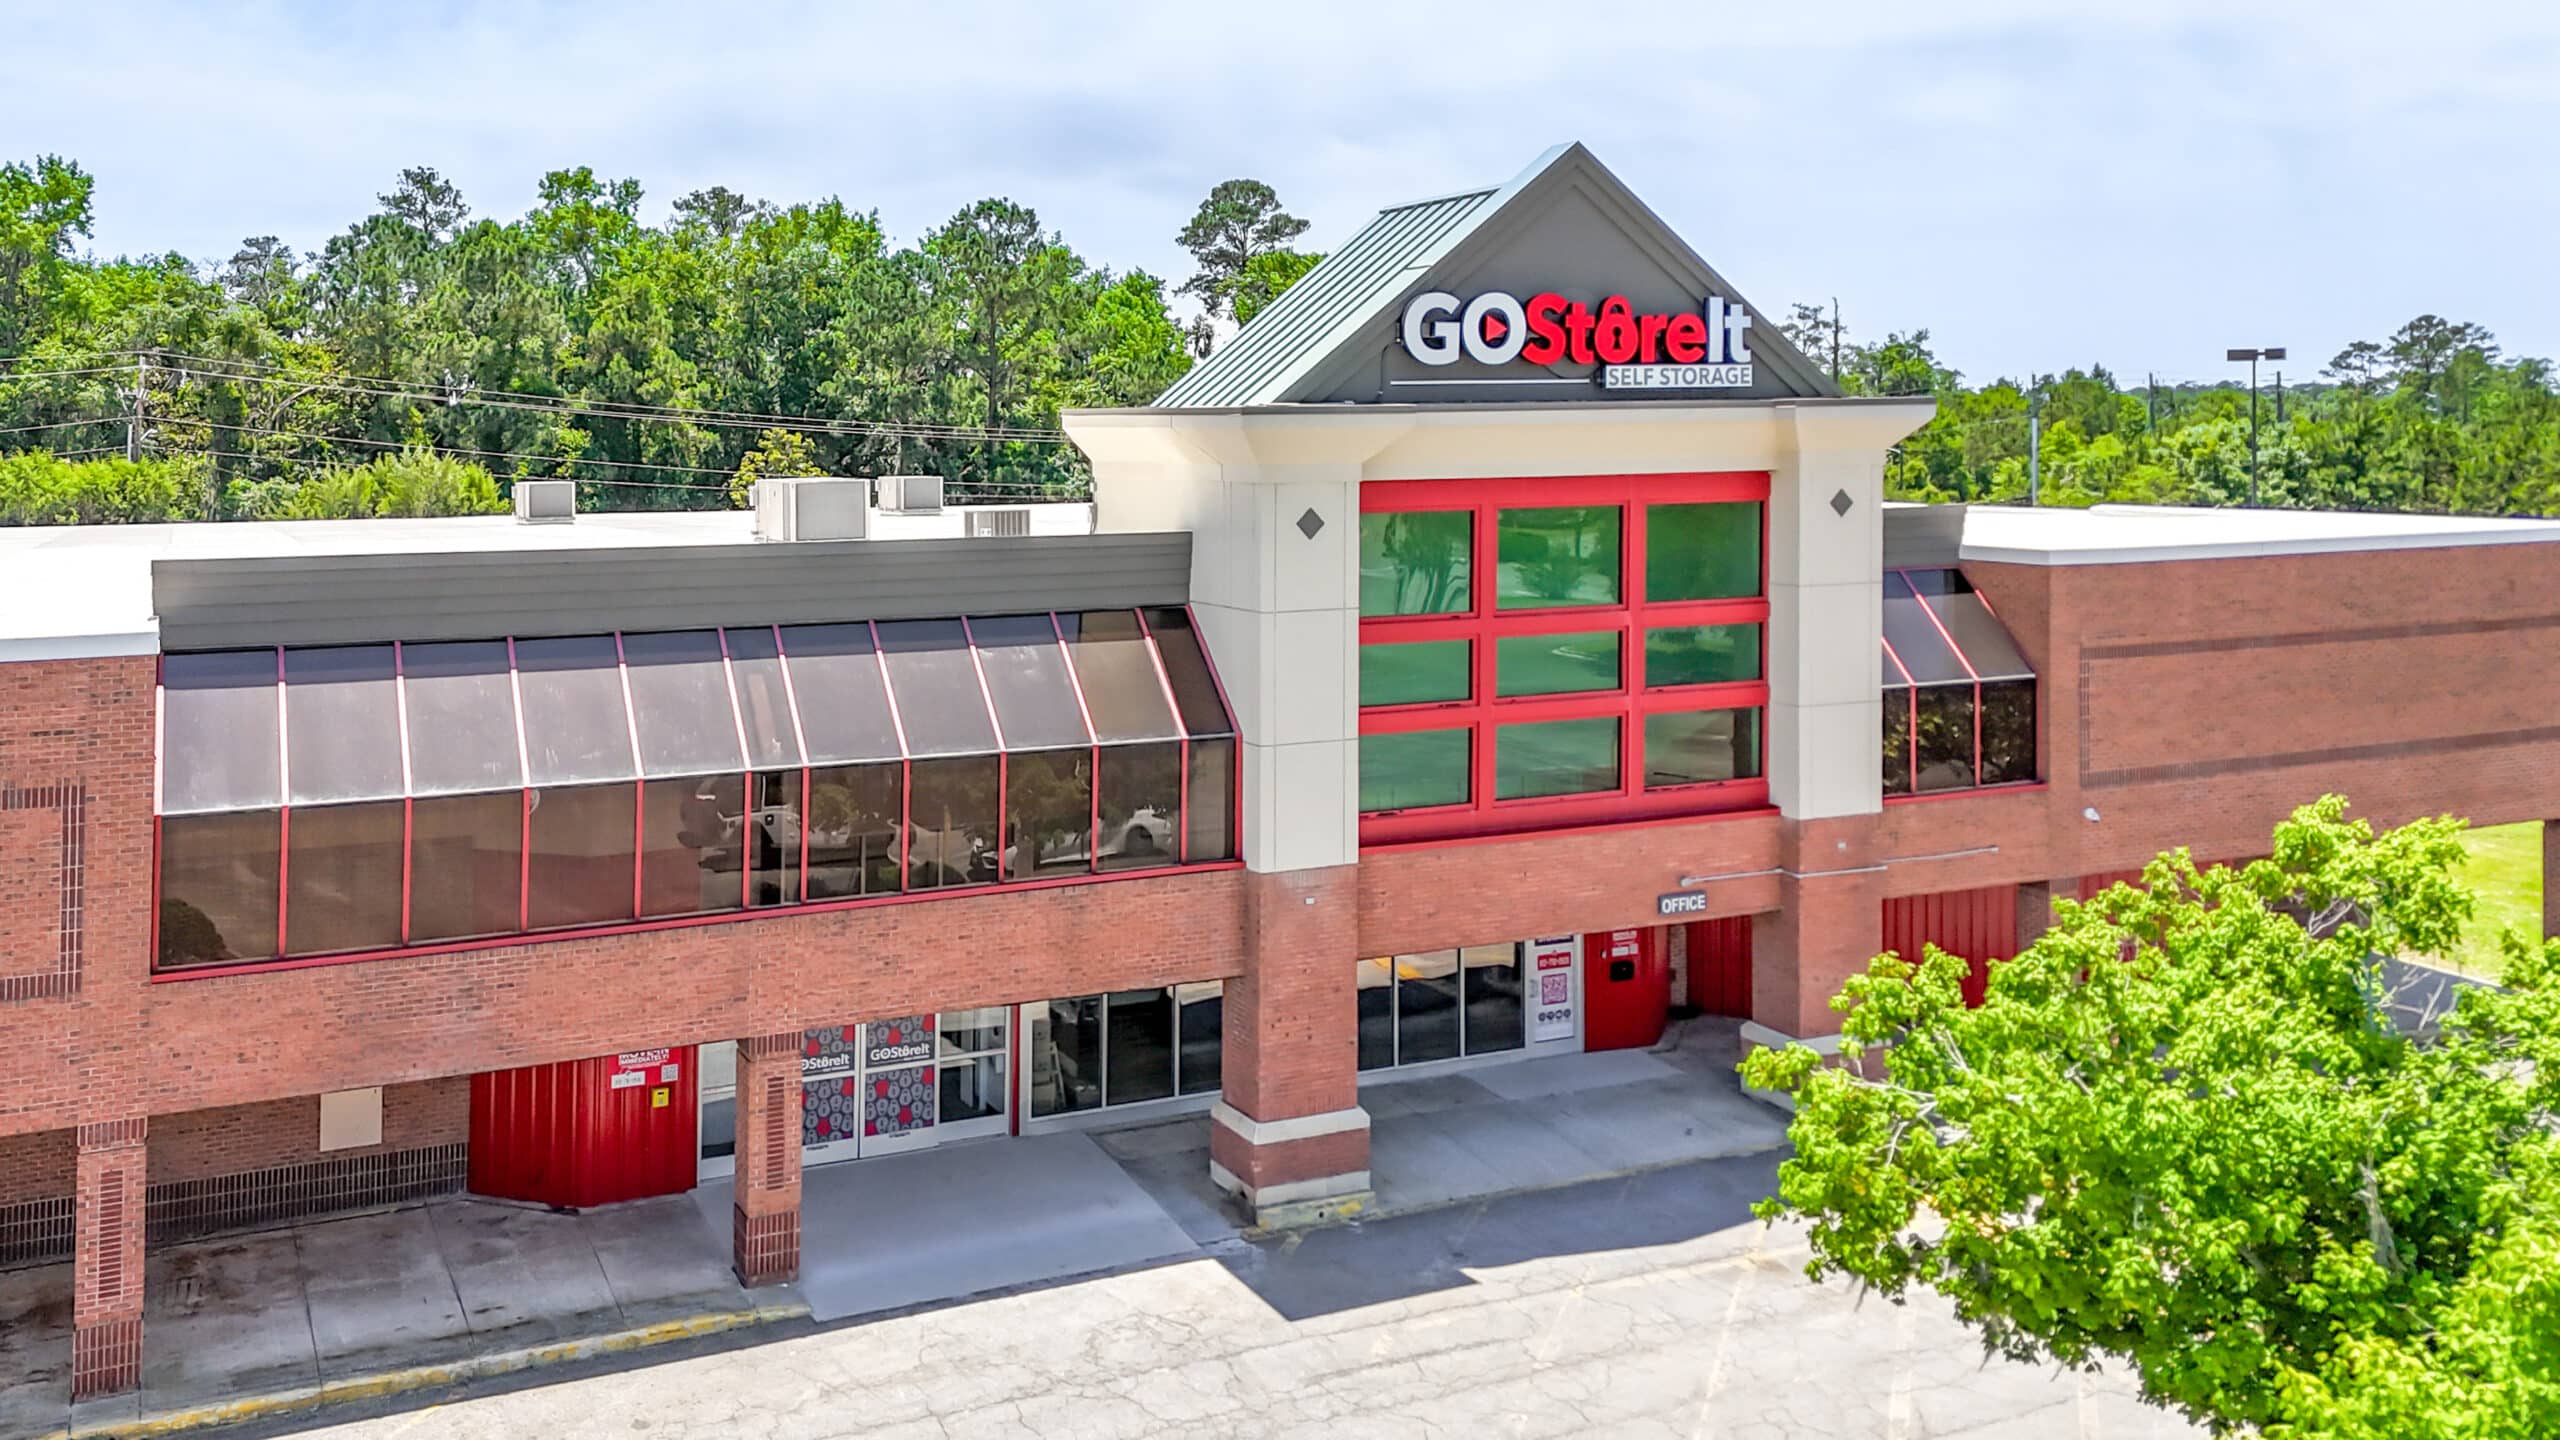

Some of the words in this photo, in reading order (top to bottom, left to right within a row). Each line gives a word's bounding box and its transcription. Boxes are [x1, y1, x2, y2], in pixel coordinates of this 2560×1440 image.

[1608, 367, 1653, 386] SELF
[1659, 366, 1751, 385] STORAGE
[1661, 894, 1706, 914] OFFICE
